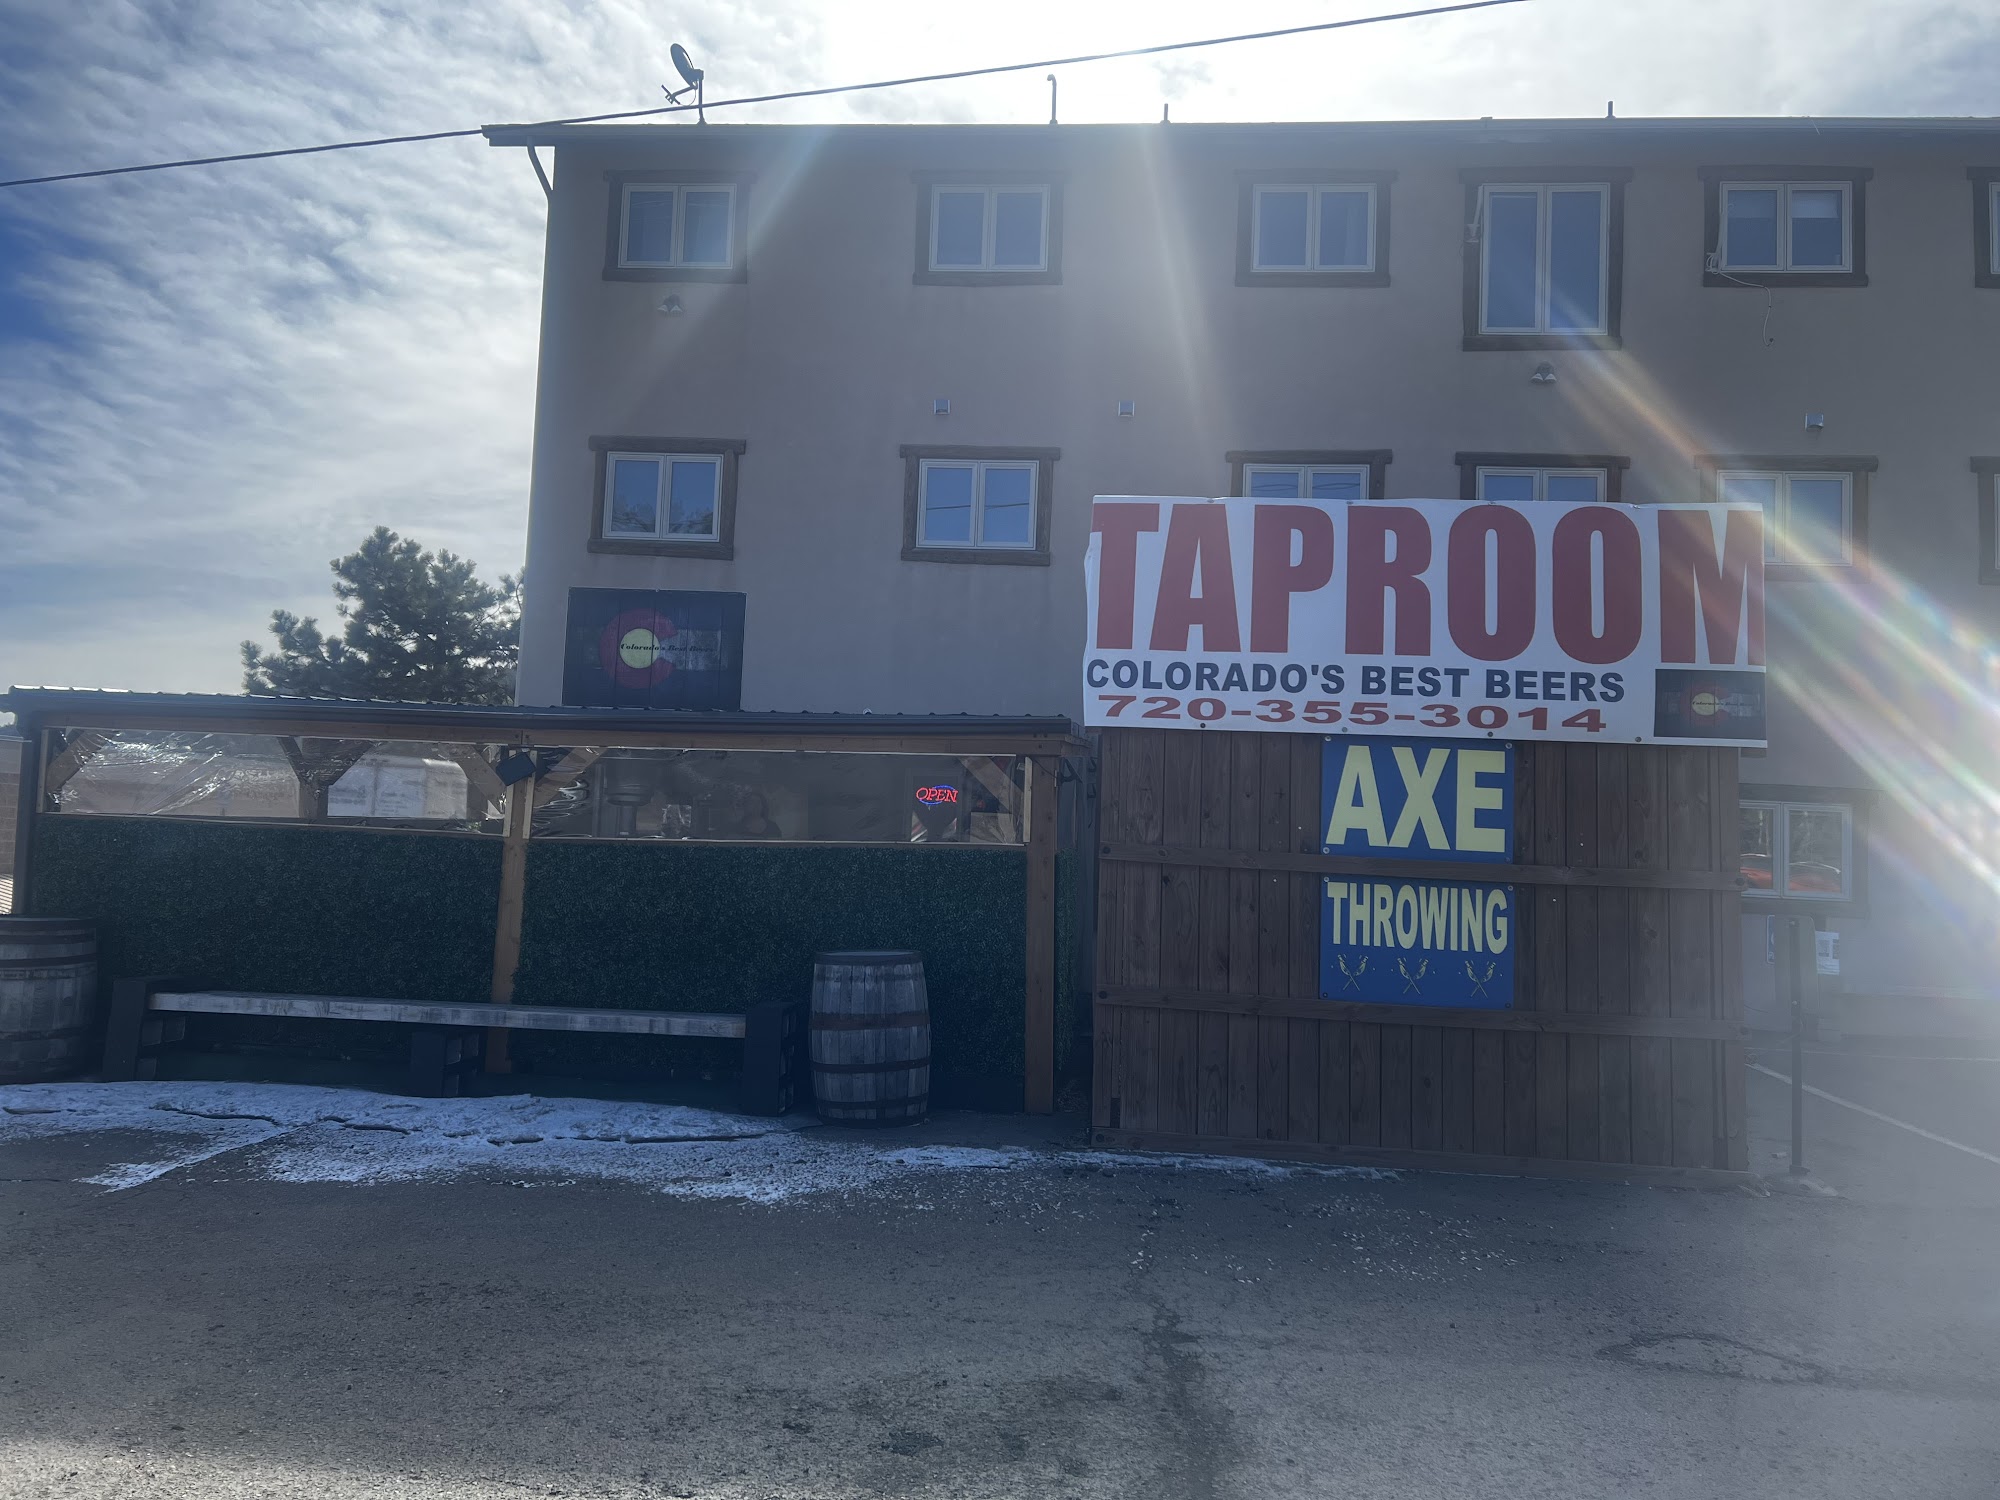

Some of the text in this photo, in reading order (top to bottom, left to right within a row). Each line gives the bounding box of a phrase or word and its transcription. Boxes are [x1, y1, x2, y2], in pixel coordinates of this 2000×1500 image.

[1091, 502, 1766, 666] TAPROOM
[620, 642, 665, 651] Colorados
[1086, 658, 1625, 703] COLORADO'S BEST BEERS
[1098, 694, 1607, 733] 720-355-3014
[916, 787, 959, 803] OPEN
[1325, 745, 1506, 853] AXE
[1327, 881, 1508, 955] THROWING
